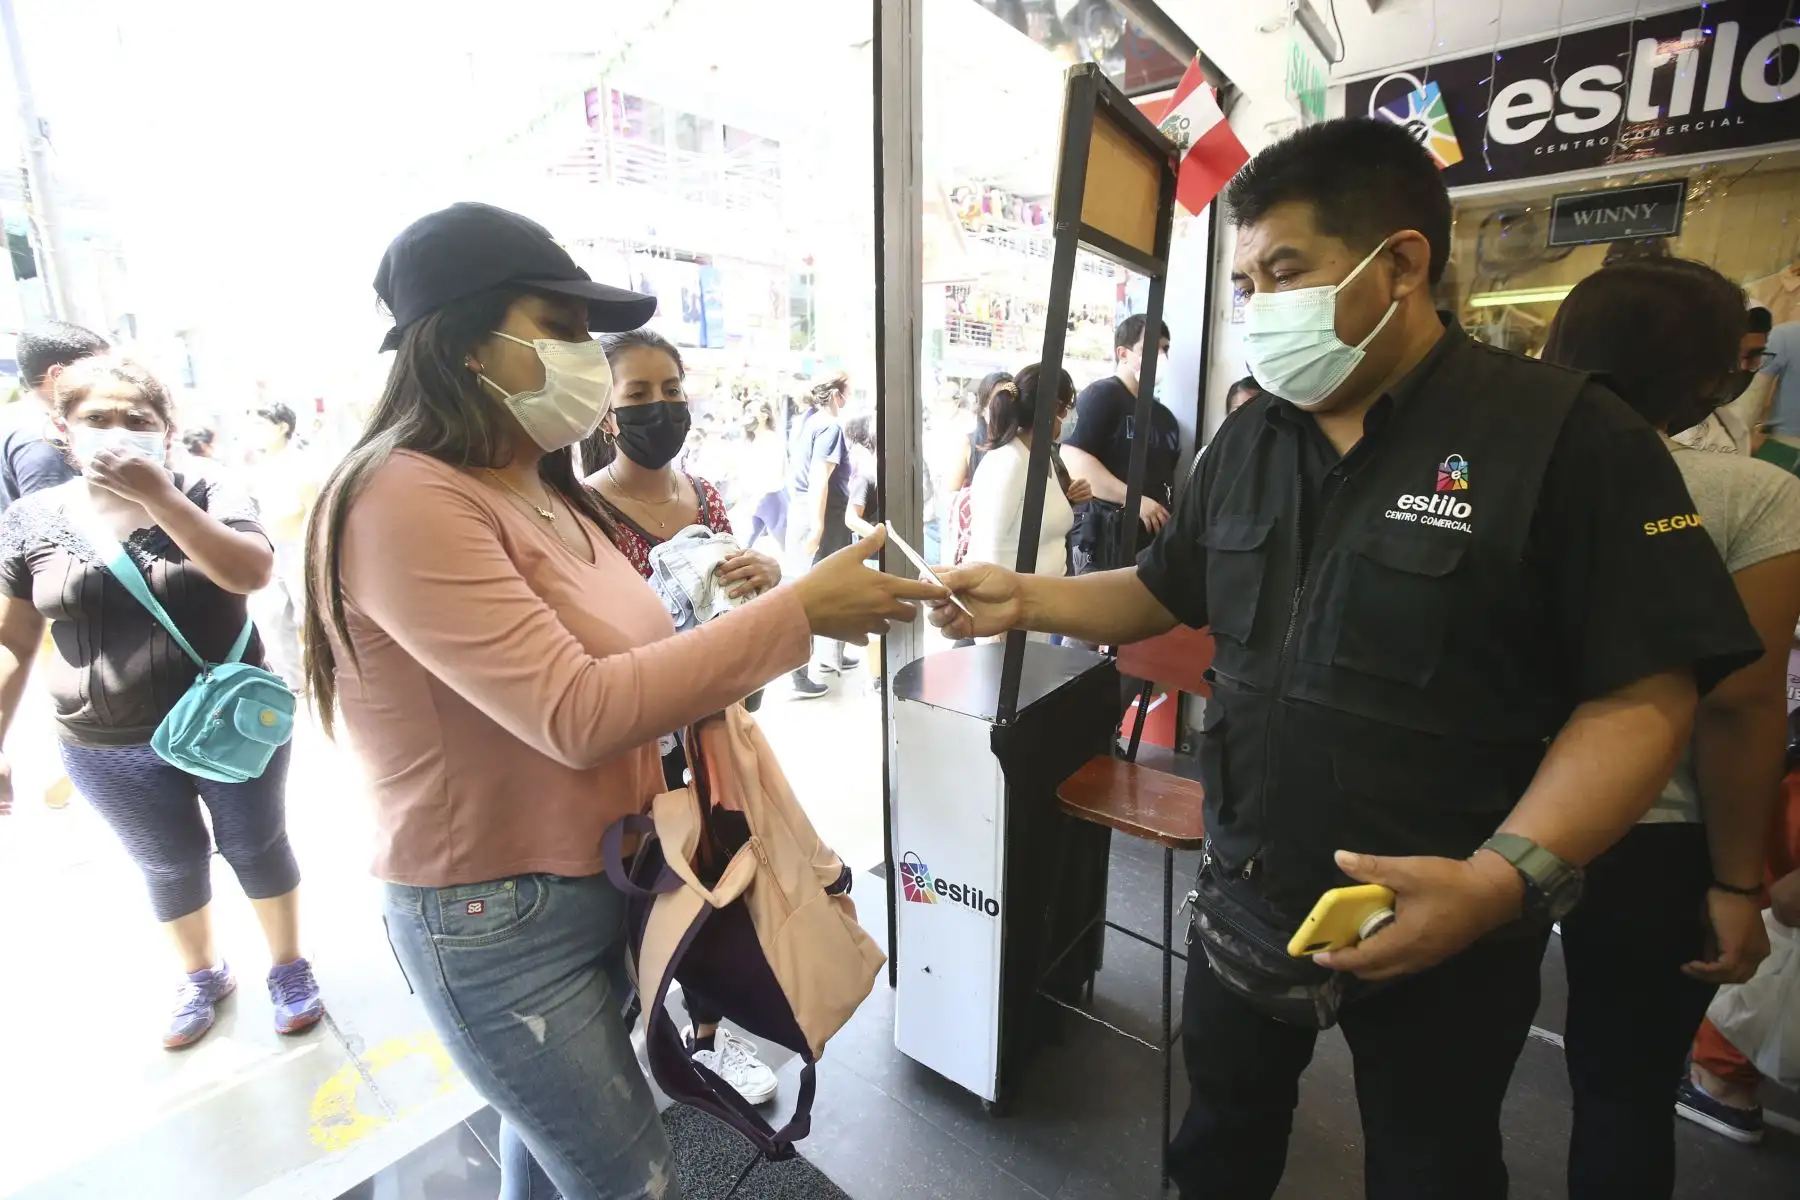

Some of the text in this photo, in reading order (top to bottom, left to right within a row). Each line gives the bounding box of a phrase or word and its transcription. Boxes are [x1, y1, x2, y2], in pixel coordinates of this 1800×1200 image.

[1488, 21, 1800, 145] estilo
[1535, 116, 1745, 155] CENTRO COMERCIAL
[1573, 202, 1659, 225] WINNY
[1397, 494, 1472, 518] estilo
[1385, 510, 1472, 533] CENTRO COMERCIAL
[1643, 513, 1702, 535] SEGU
[934, 878, 999, 916] estilo
